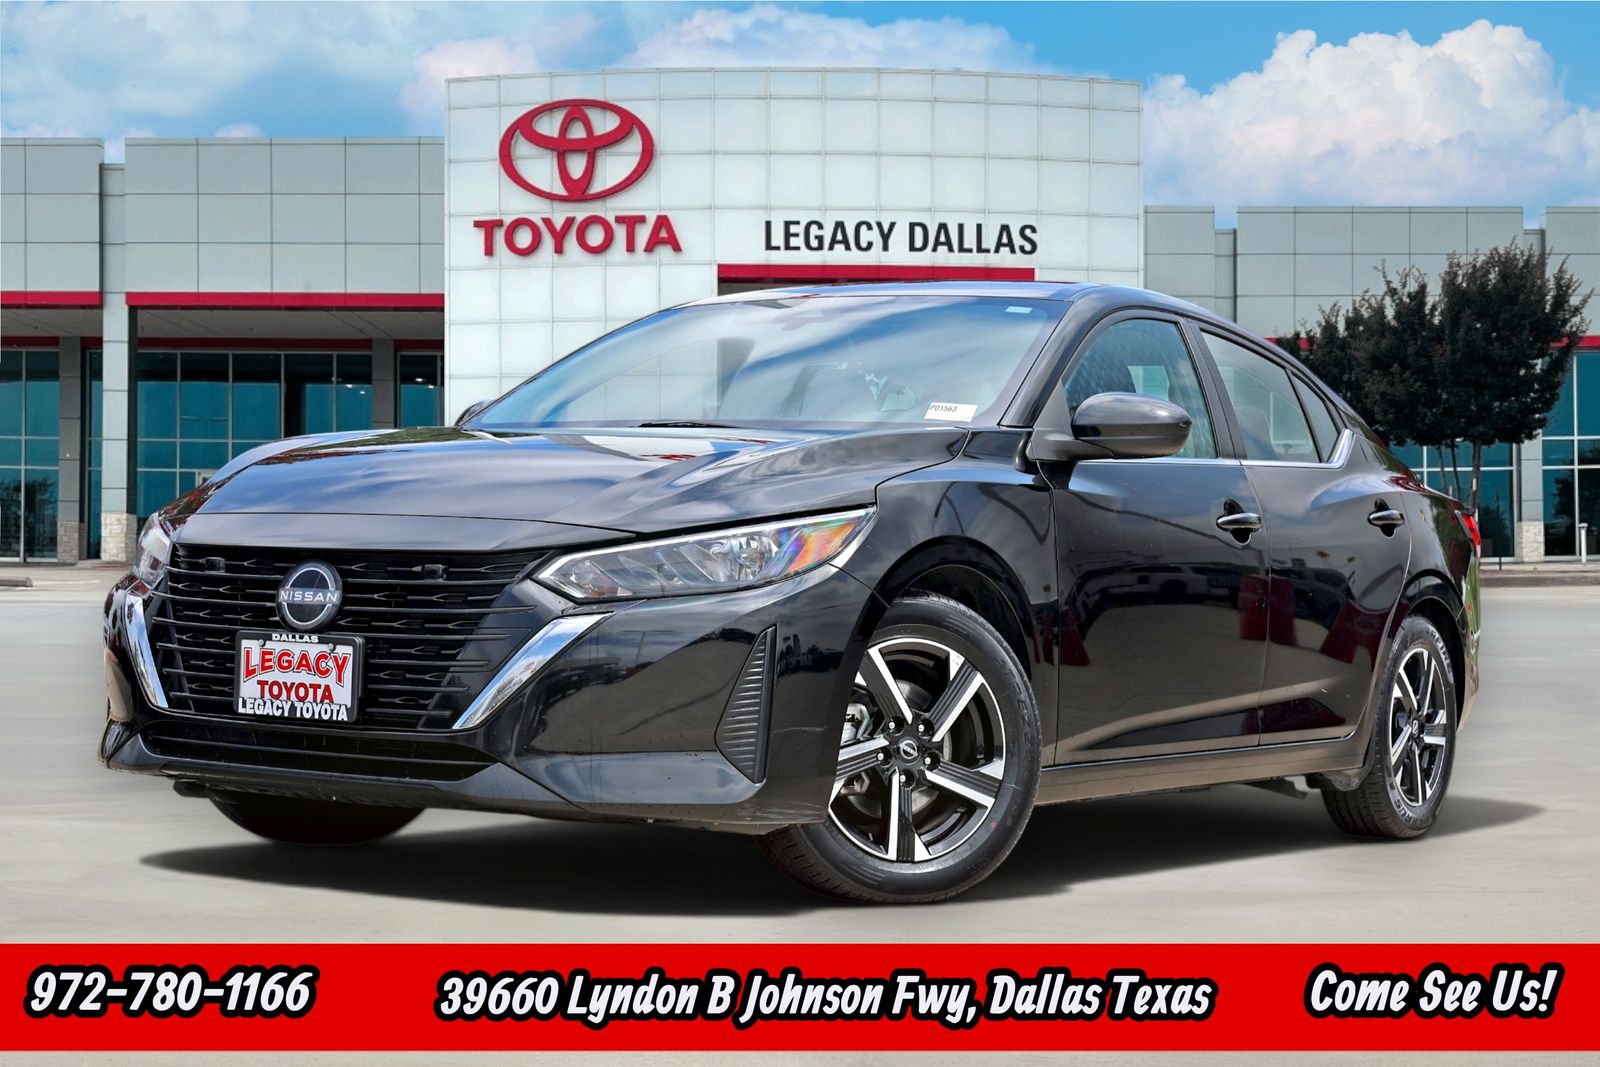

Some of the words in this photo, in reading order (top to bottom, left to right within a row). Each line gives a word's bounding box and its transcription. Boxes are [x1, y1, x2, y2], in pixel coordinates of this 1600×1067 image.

[473, 214, 683, 257] TOYOTA
[764, 220, 897, 252] LEGACY
[908, 221, 1039, 256] DALLAS
[279, 590, 339, 602] NISSAN
[271, 633, 319, 643] DALLAS
[243, 647, 351, 687] LEGACY
[256, 679, 335, 704] TOYOTA
[238, 698, 292, 717] LEGACY
[294, 701, 349, 722] TOYOTA
